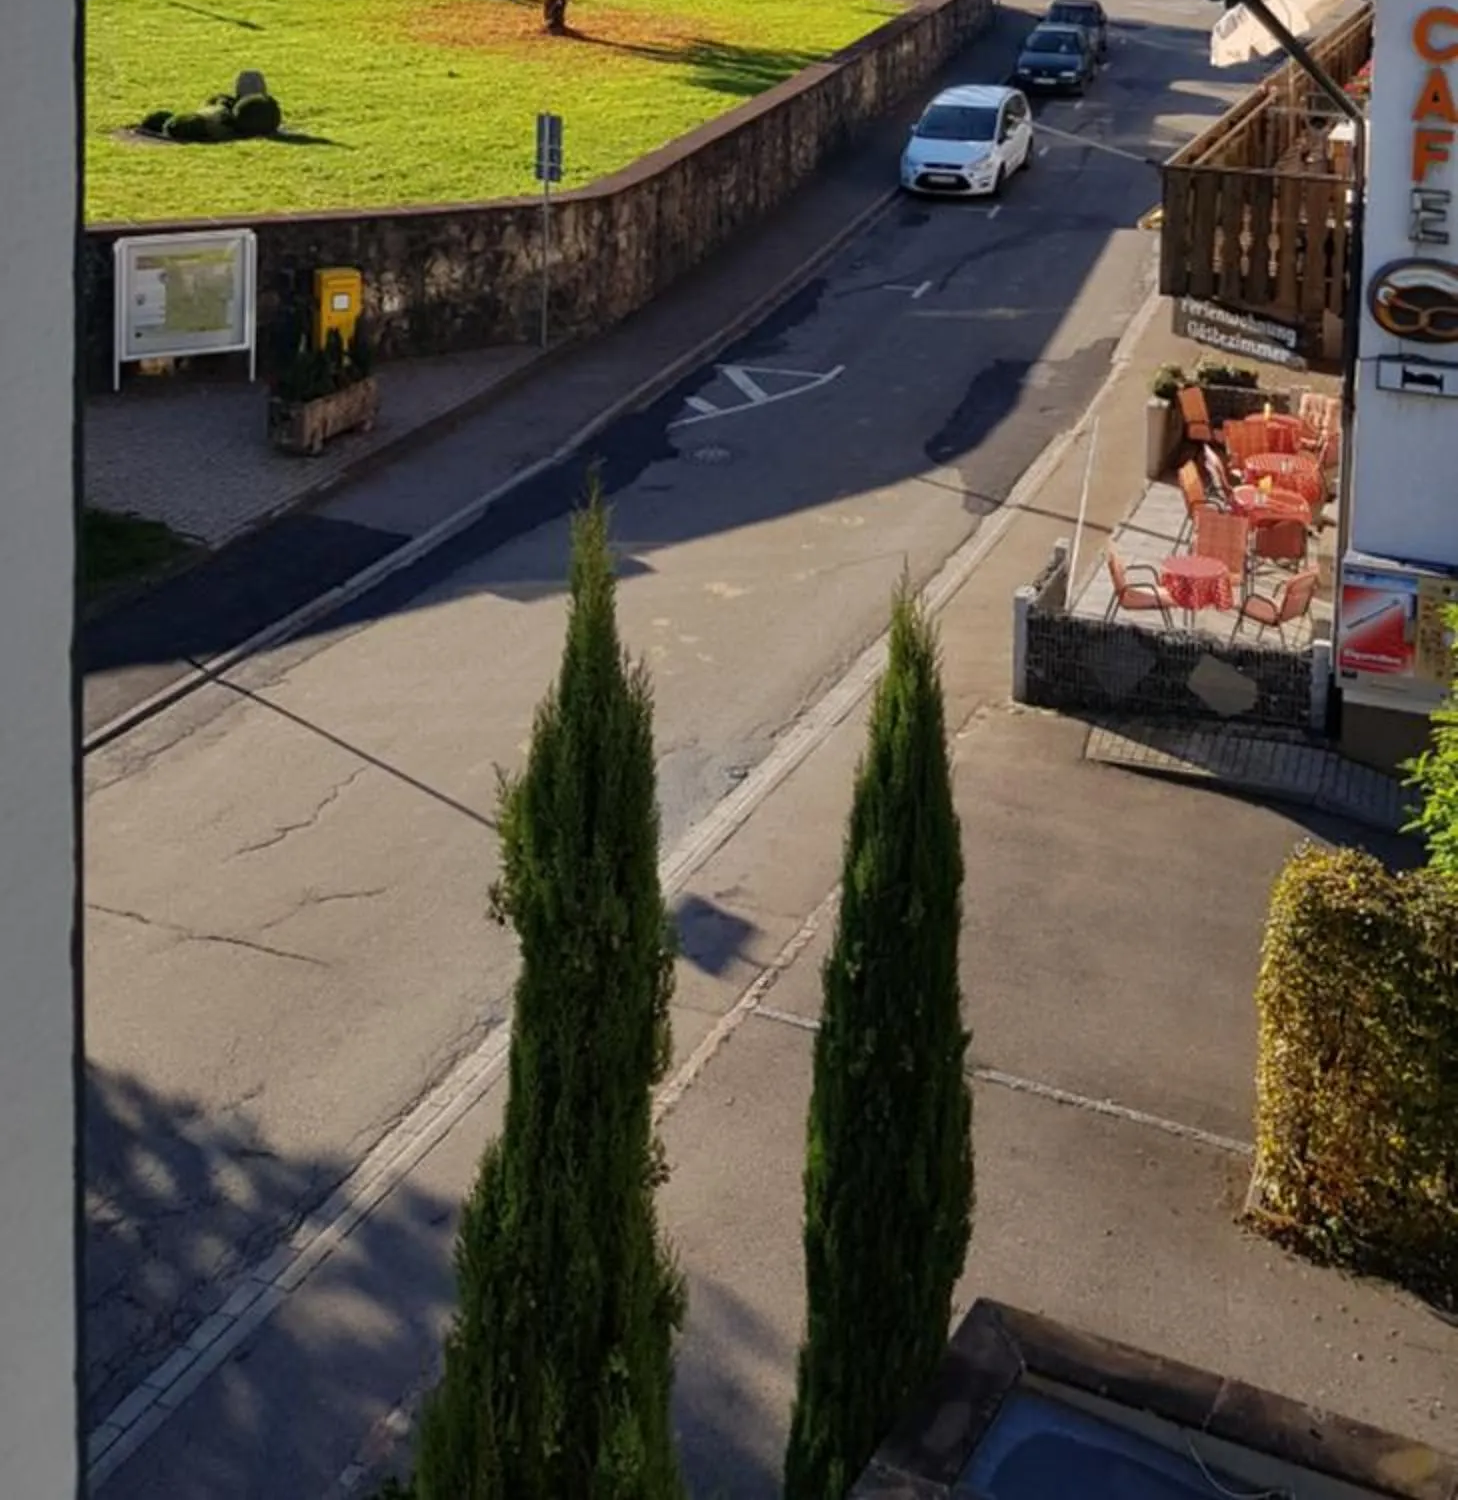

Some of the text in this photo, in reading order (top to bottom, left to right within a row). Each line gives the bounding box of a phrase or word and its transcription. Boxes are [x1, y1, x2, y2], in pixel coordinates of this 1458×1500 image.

[1409, 6, 1458, 245] CAFE
[1181, 295, 1296, 348] Ferienwohnung
[1187, 320, 1291, 363] Gästezimmer
